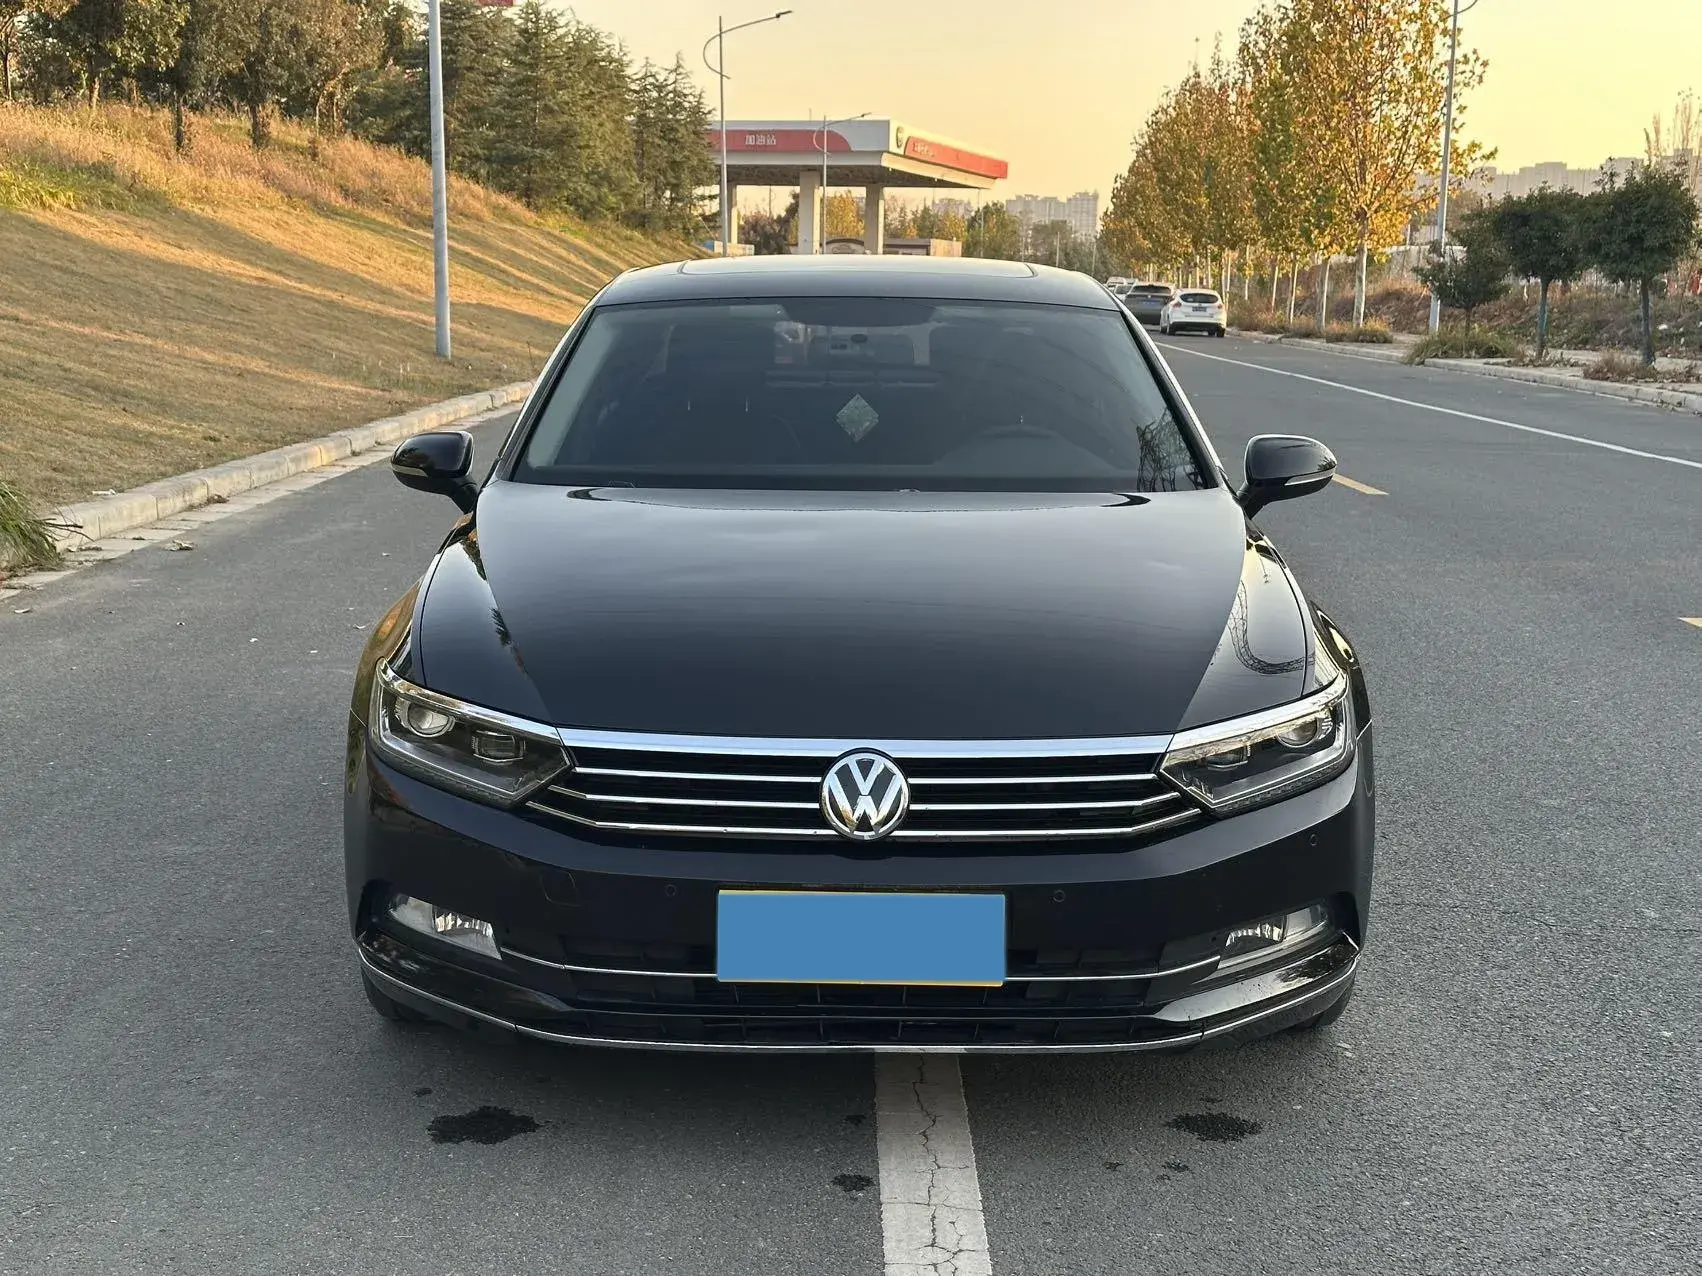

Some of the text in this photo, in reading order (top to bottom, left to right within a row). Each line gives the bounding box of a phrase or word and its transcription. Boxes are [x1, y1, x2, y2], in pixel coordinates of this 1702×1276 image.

[744, 134, 776, 146] 加油站
[825, 756, 906, 836] VW
